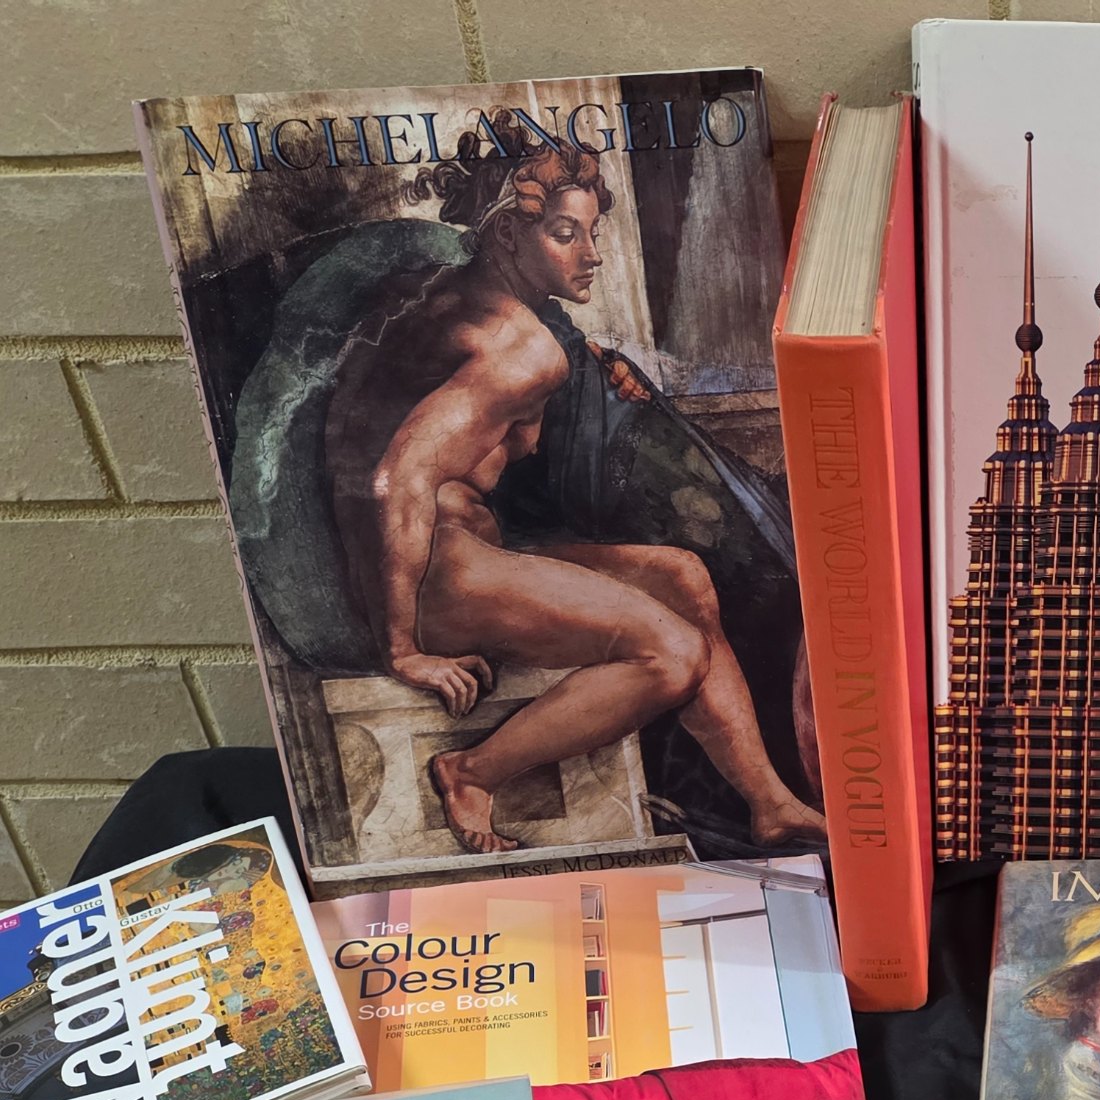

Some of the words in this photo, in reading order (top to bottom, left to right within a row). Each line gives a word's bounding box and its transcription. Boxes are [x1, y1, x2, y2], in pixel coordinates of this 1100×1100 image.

[176, 96, 748, 176] MICHELANGELO
[809, 386, 861, 489] THE
[819, 497, 874, 664] WORLD
[835, 669, 876, 724] IN
[841, 723, 888, 850] VOGUE
[73, 899, 103, 914] Otto
[120, 904, 170, 927] Gustav
[366, 922, 409, 937] The
[334, 932, 501, 970] Colour
[126, 888, 246, 1095] Klimt
[360, 958, 535, 999] Design
[358, 999, 446, 1021] Source
[456, 992, 518, 1011] Book
[386, 1022, 412, 1032] USING
[453, 1016, 482, 1026] PAINTS
[483, 1015, 490, 1023] &
[492, 1010, 548, 1022] ACCESSORIES
[386, 1032, 402, 1040] FOR
[404, 1026, 457, 1038] SUCCESSFUL
[459, 1022, 511, 1033] DECORATING
